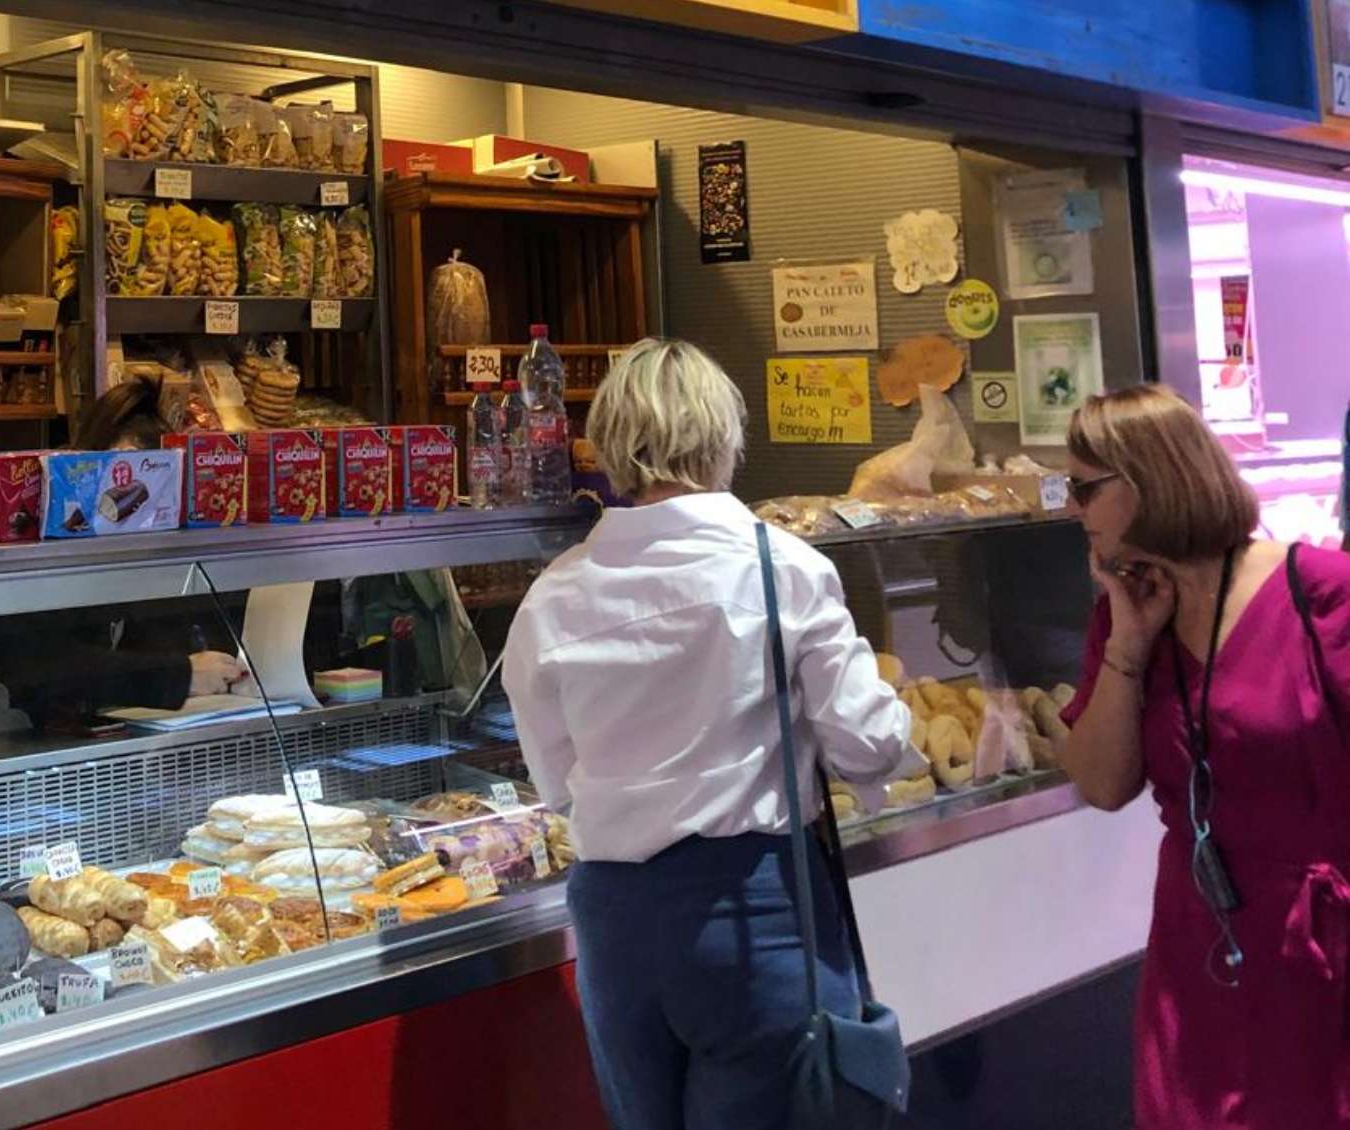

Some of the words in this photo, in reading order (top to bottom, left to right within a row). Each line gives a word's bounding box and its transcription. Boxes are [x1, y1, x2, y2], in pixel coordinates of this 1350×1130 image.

[786, 286, 811, 299] PAN
[820, 305, 835, 316] DE
[782, 324, 871, 339] CASABERMEJA
[773, 366, 789, 386] Se
